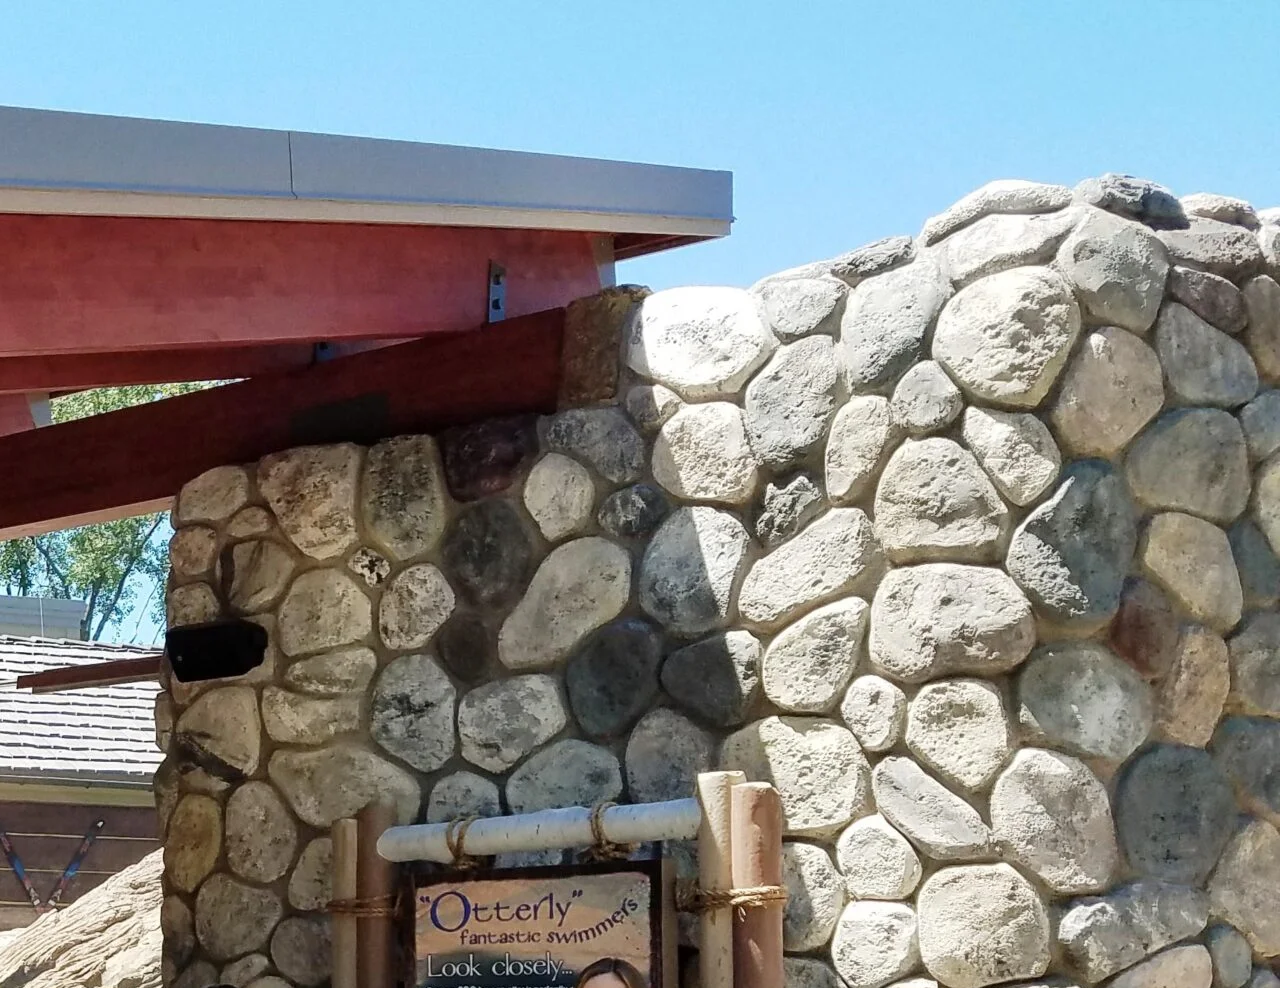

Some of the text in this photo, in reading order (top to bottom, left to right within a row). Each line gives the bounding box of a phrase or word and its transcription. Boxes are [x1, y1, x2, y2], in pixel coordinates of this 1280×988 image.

[420, 889, 583, 932] "Otterly"
[460, 898, 638, 945] fantastic swimmers
[427, 951, 572, 981] Look closely...
